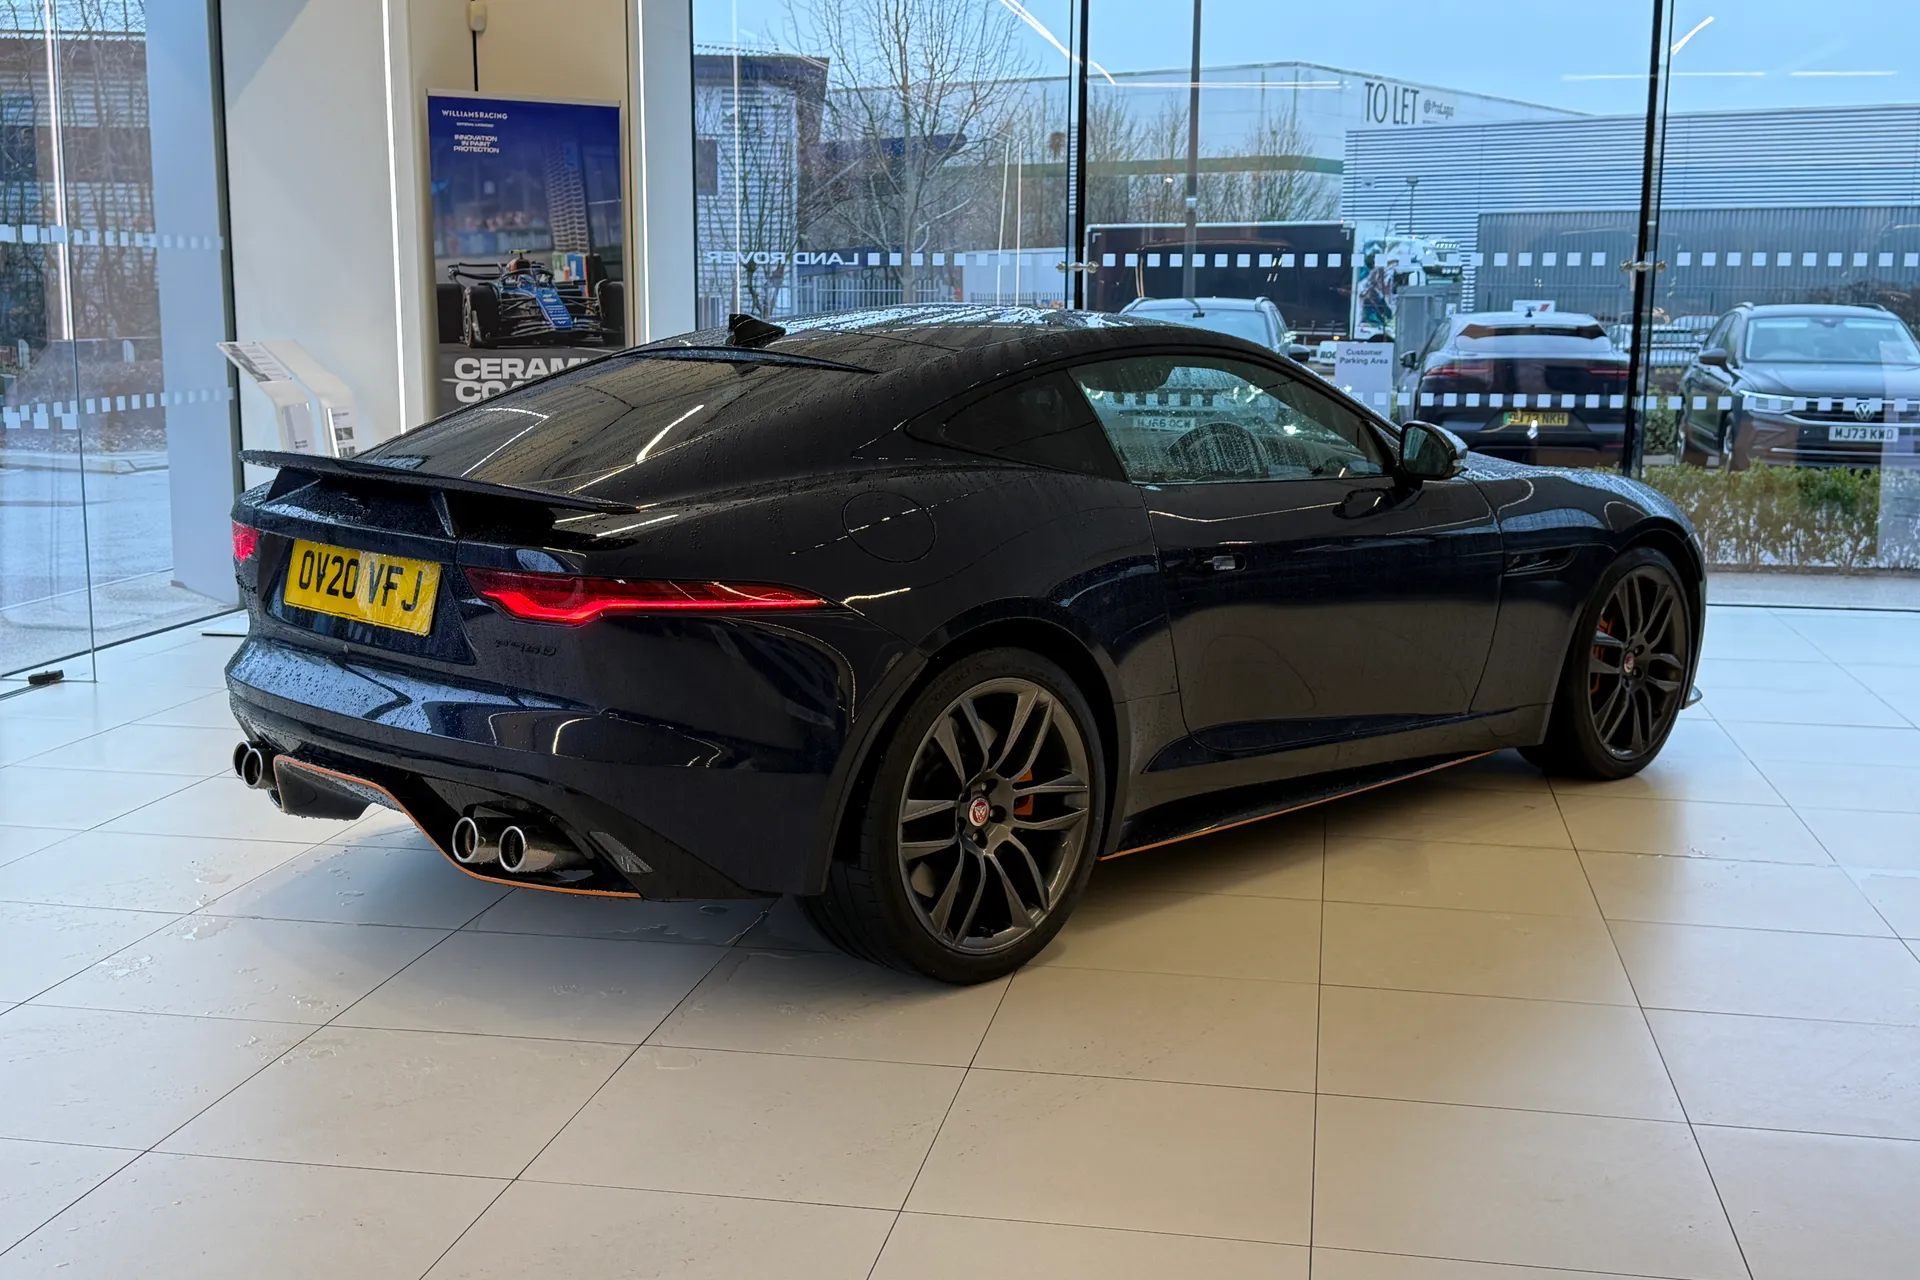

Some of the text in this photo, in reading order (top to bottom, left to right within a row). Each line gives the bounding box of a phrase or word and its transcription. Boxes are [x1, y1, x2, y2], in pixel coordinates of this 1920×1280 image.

[1364, 81, 1420, 125] TO LET
[454, 134, 498, 142] INNOVATION
[453, 145, 500, 153] PROTECTION
[1346, 348, 1383, 356] Customer
[1340, 356, 1368, 366] Parking
[454, 357, 588, 380] CERAM
[1834, 427, 1867, 439] MJ73
[299, 550, 424, 612] OV20 VFJ
